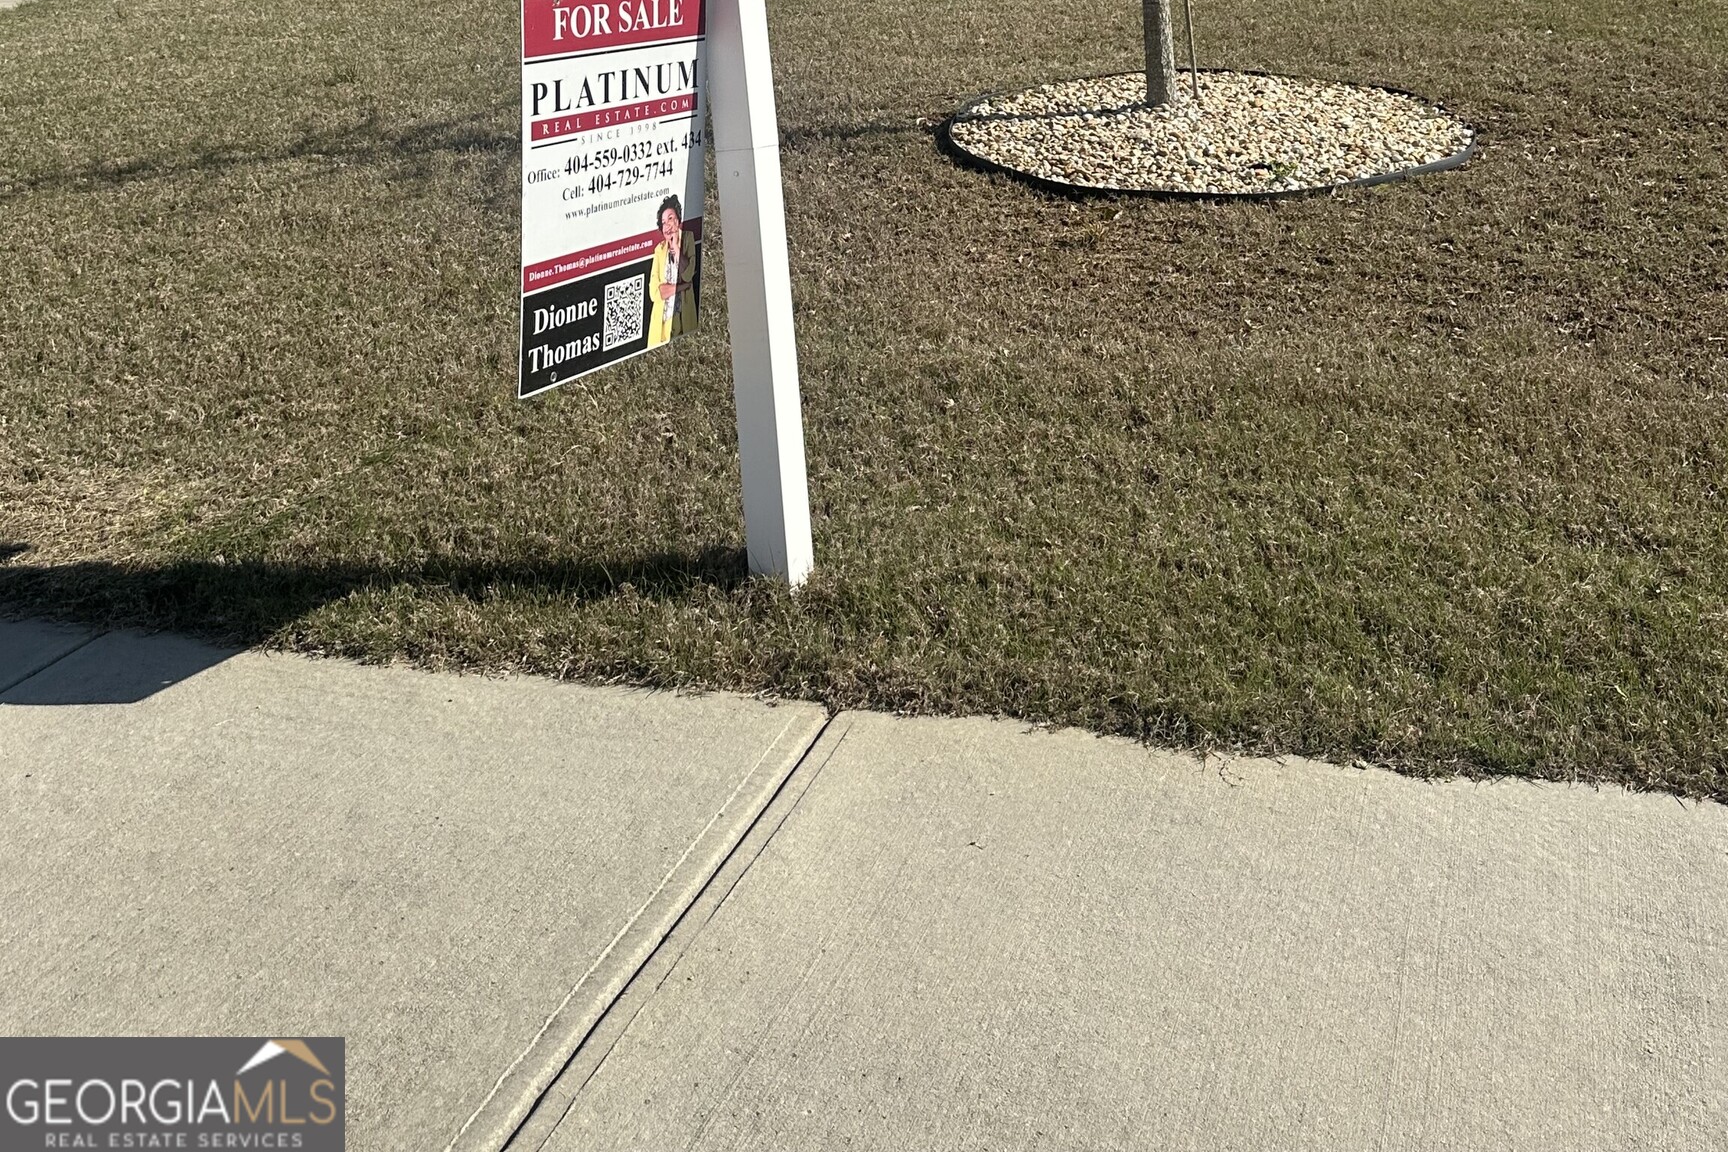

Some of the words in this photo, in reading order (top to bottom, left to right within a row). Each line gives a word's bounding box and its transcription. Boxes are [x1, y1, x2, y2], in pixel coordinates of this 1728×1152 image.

[552, 3, 613, 41] FOR
[530, 59, 699, 117] PLATINUM
[541, 117, 582, 135] REAL
[595, 98, 689, 125] ESTATE.COM
[581, 128, 621, 145] SINCE
[630, 121, 657, 136] 1998
[527, 168, 560, 185] Office:
[564, 140, 652, 176] 404-559-0332
[656, 140, 678, 156] ext.
[681, 129, 702, 150] 434
[562, 185, 584, 201] Cell:
[588, 158, 673, 194] 404-729-7744
[565, 187, 670, 220] www.platinumrealestate.com
[529, 239, 653, 282] Dionne.Thomas@platinumrealestate.com
[532, 297, 598, 336] Dionne
[528, 331, 600, 374] Thomas
